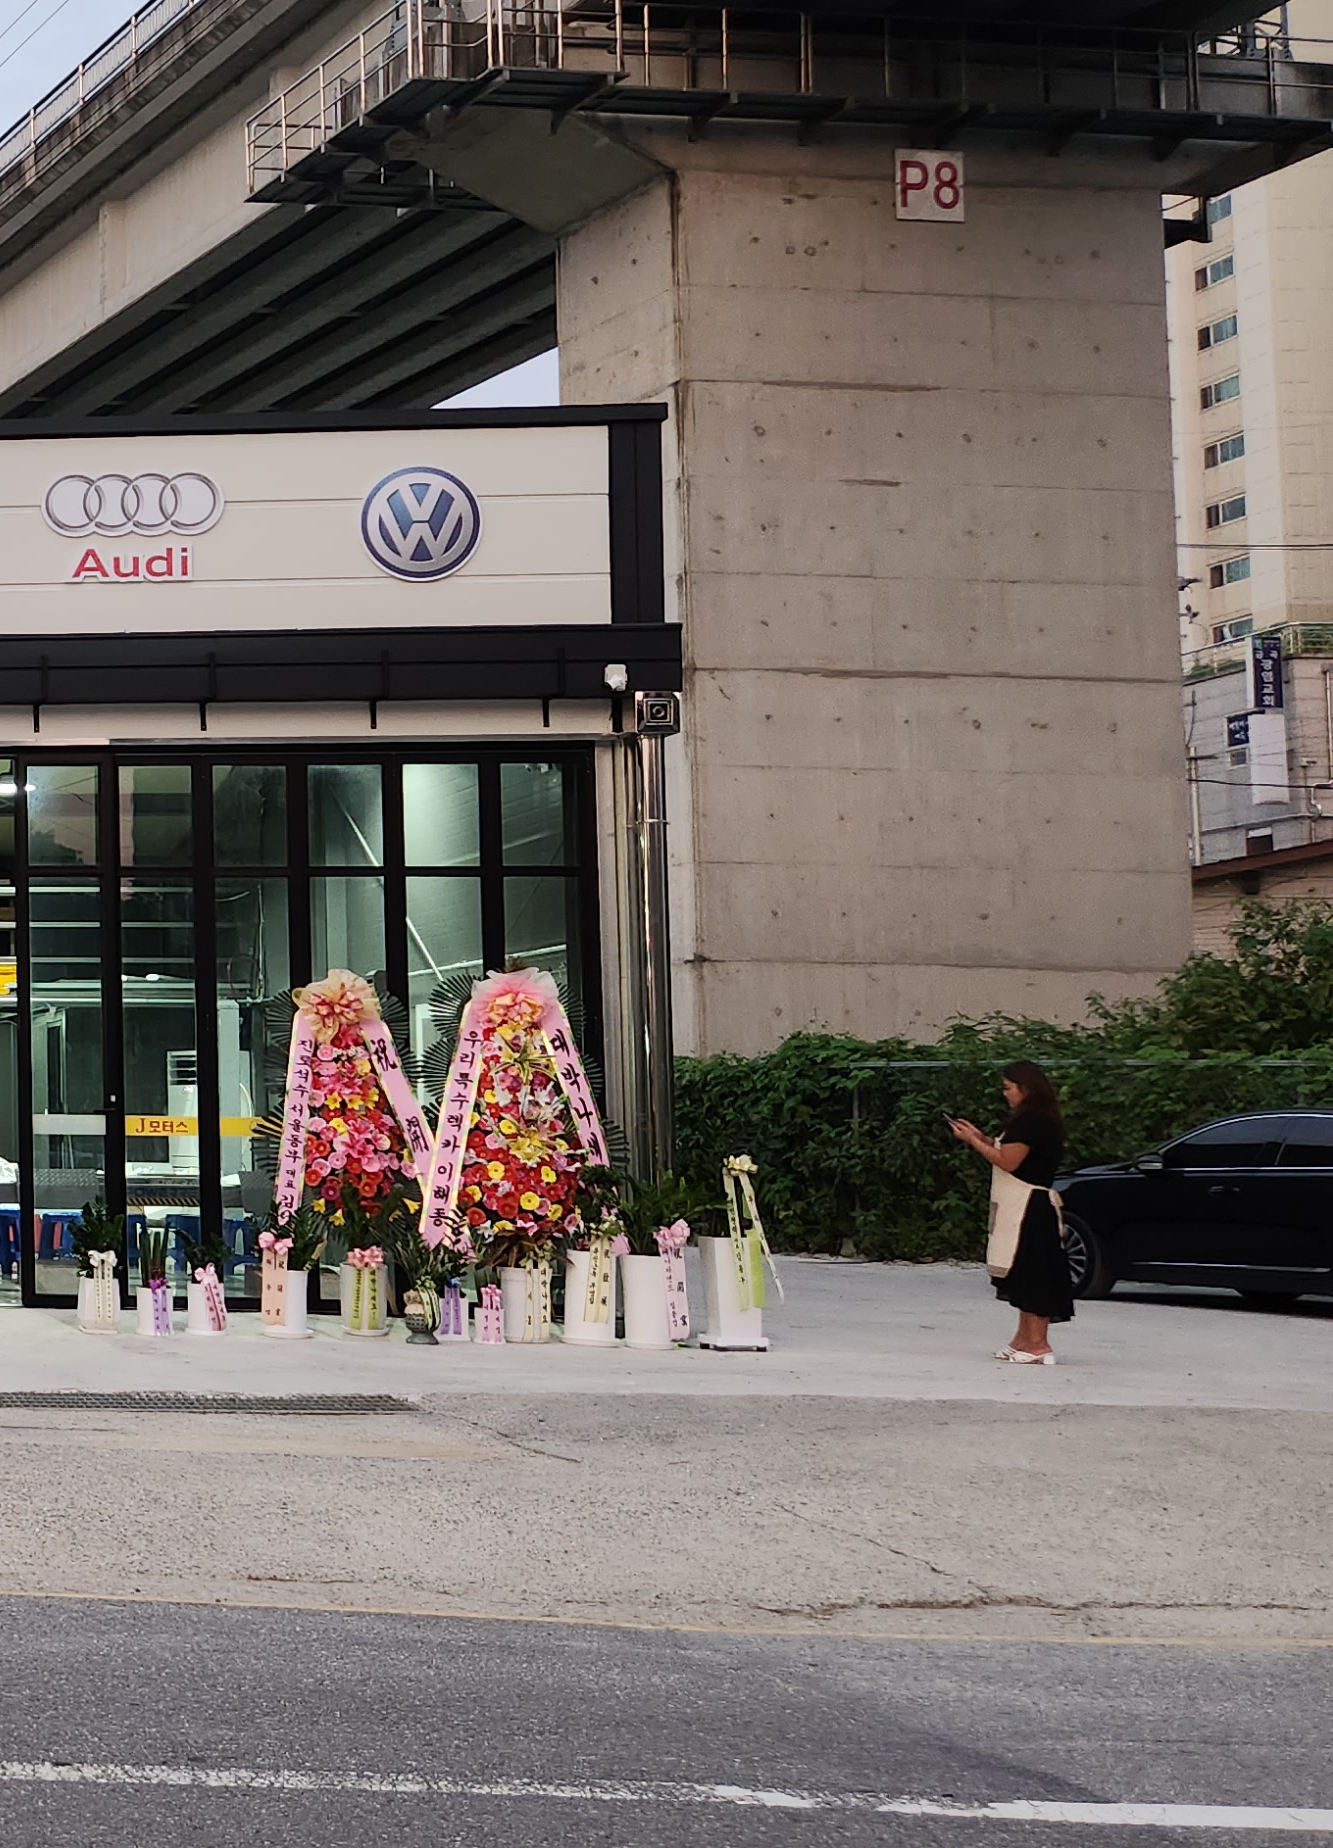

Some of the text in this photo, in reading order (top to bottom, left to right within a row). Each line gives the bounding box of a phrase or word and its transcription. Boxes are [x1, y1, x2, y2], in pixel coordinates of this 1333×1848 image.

[899, 160, 961, 209] P8
[73, 547, 189, 578] Audi
[441, 1030, 481, 1154] 우리특수렉카
[550, 1028, 603, 1163] 대박나세
[135, 1118, 189, 1134] J 모터스
